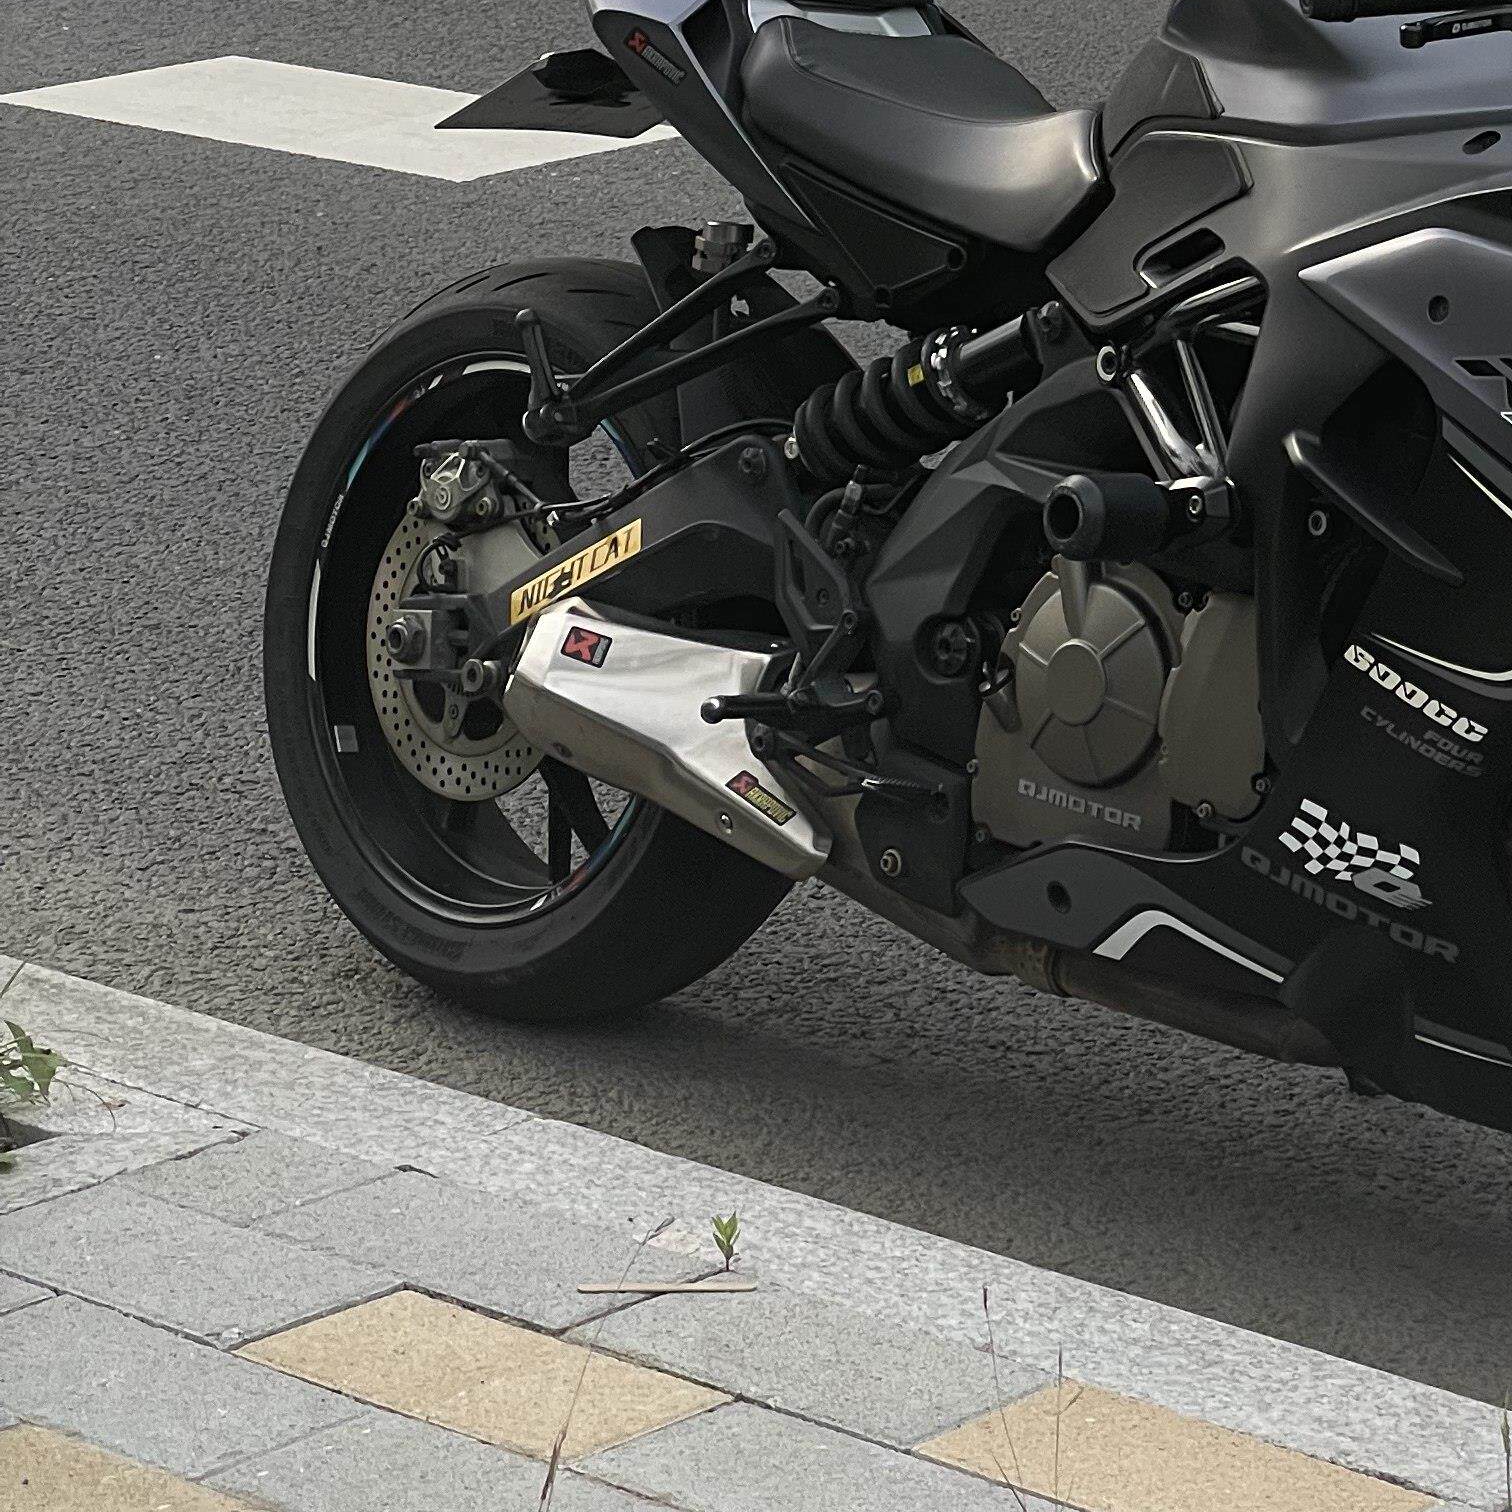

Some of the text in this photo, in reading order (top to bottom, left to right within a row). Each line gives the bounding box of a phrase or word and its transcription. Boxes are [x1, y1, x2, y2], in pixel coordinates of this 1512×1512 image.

[1343, 644, 1489, 742] 600CC
[1423, 730, 1484, 764] FOUR
[1016, 778, 1141, 831] QJMOTOR
[1241, 846, 1460, 964] QJMOTOR
